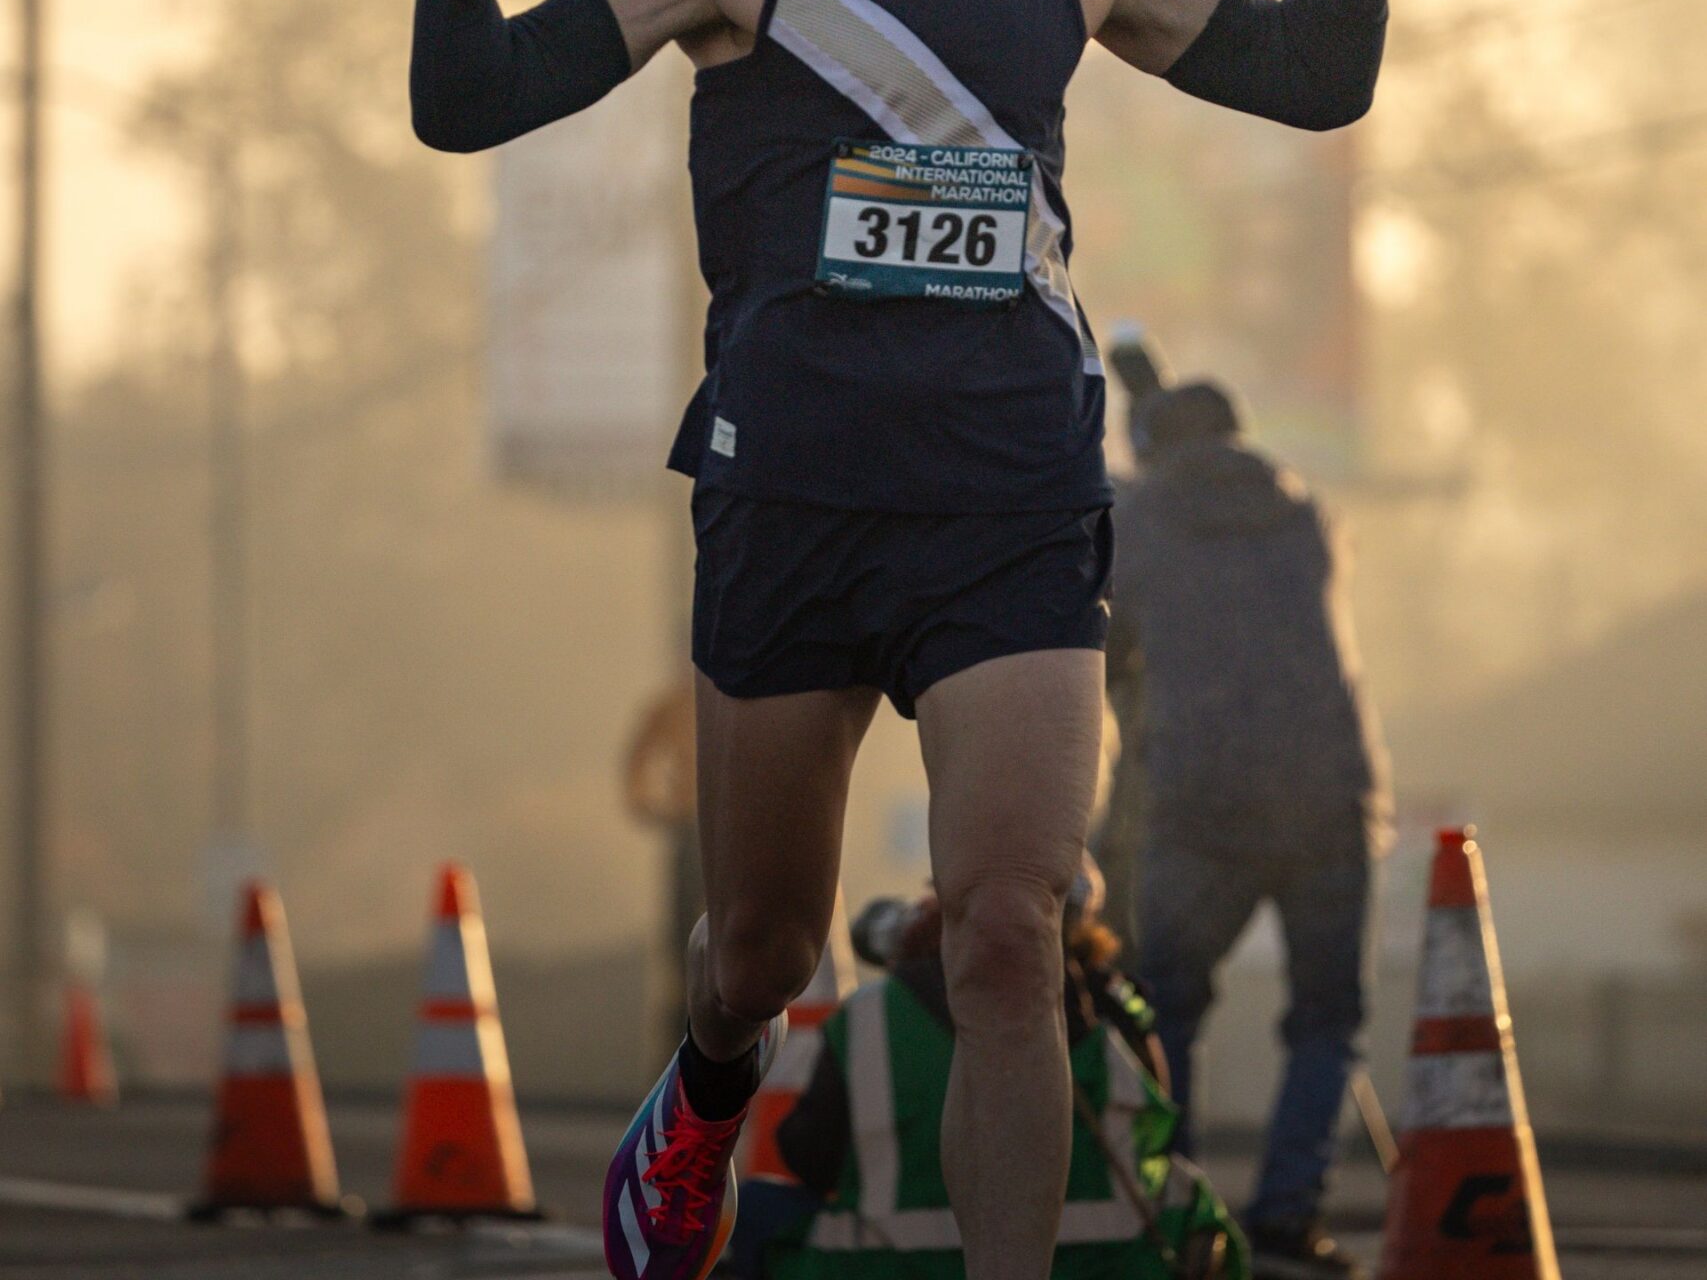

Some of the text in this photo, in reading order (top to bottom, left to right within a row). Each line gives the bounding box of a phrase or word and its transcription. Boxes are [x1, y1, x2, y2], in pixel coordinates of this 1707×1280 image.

[868, 145, 917, 163] 2024
[931, 150, 1019, 169] CALIFORNI
[895, 165, 1028, 186] INTERNATIONAL
[930, 184, 1028, 203] MARATHON
[854, 206, 998, 266] 3126
